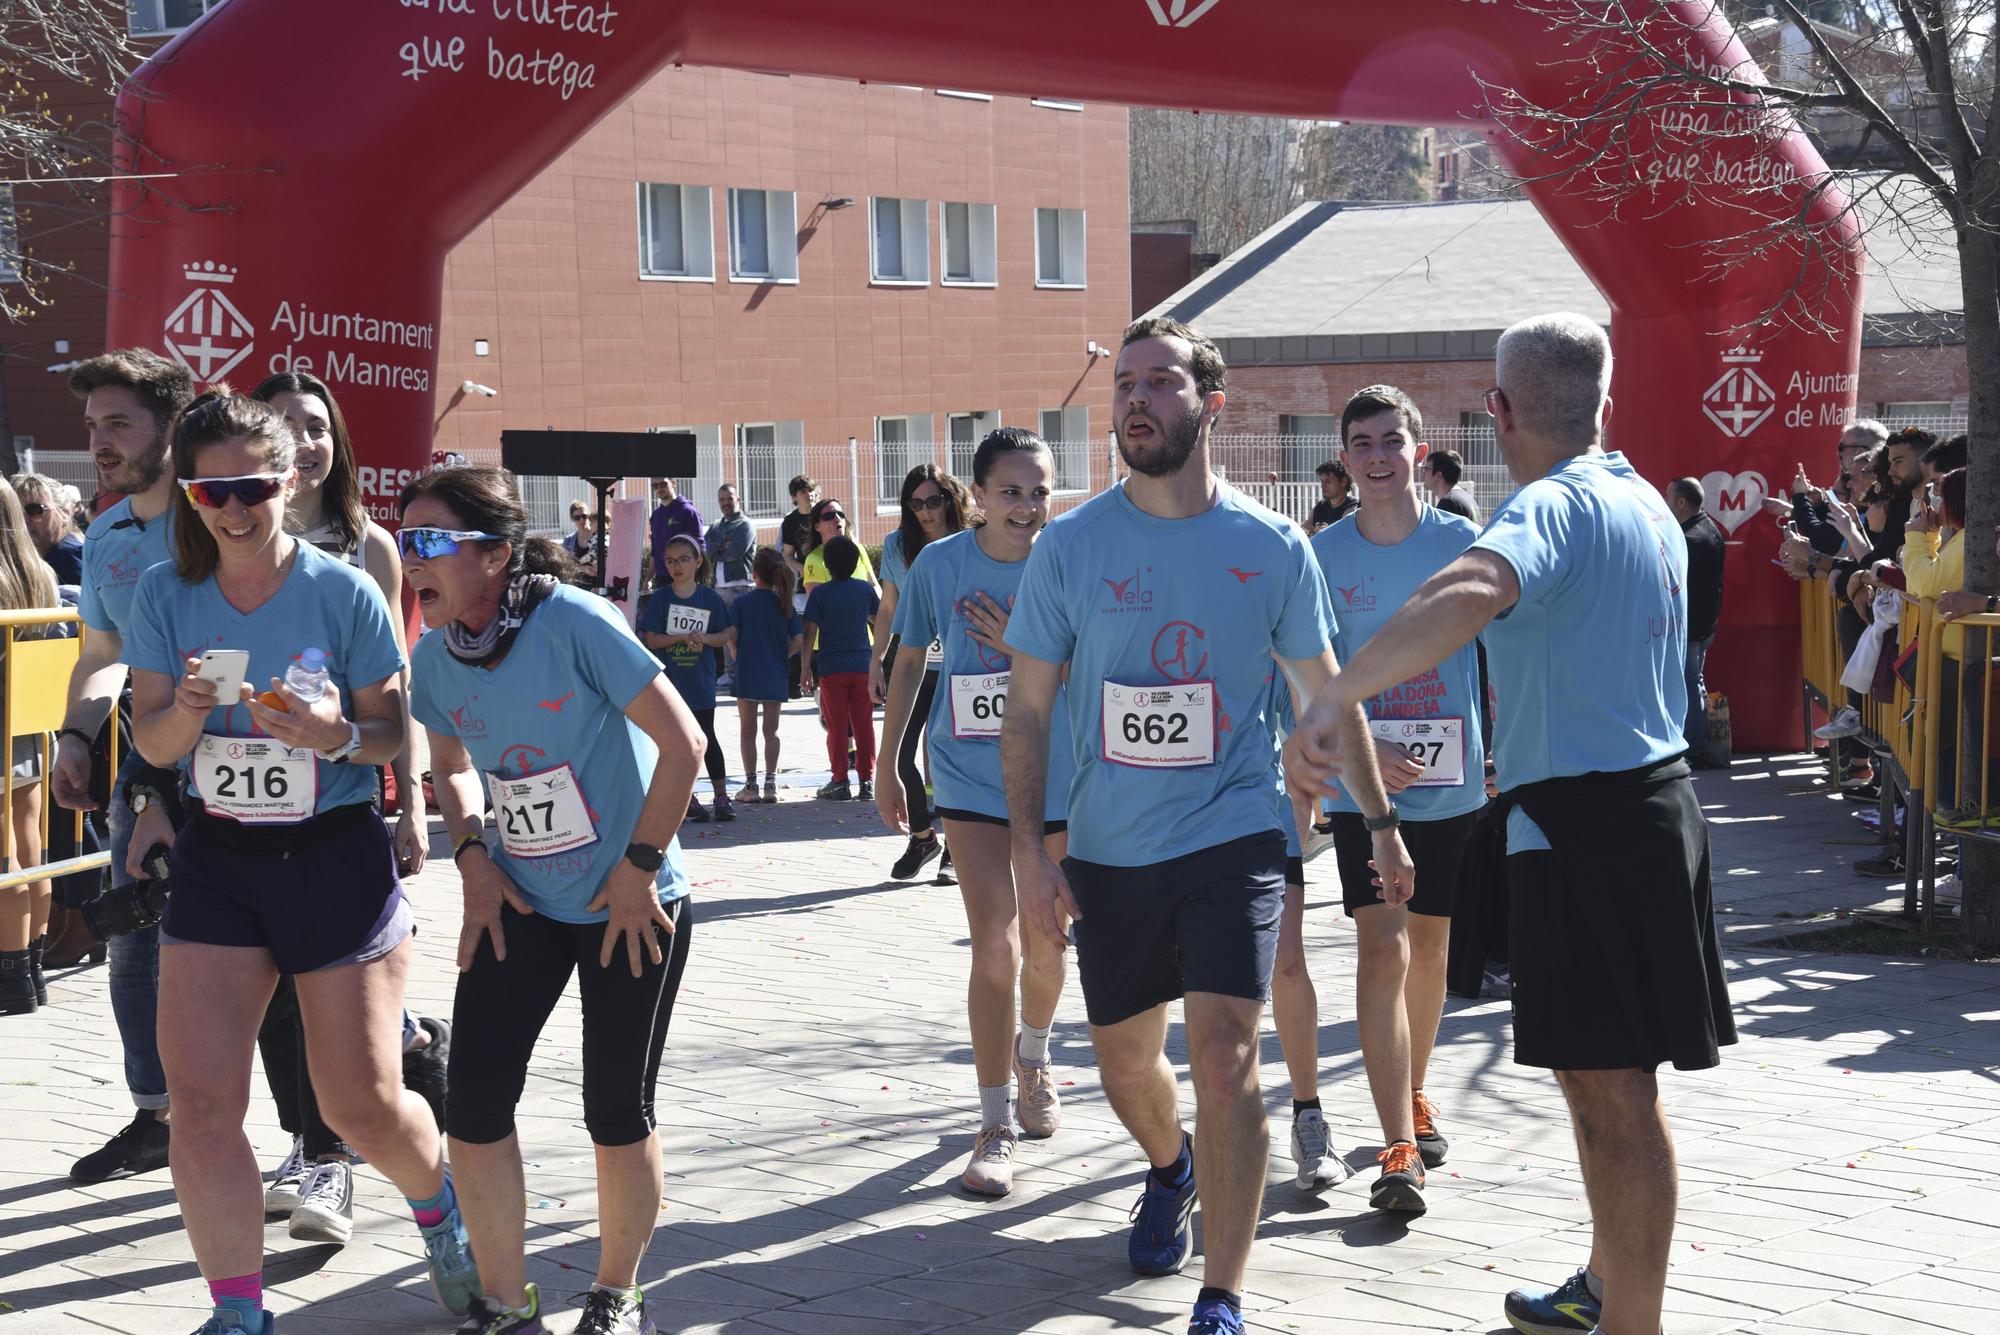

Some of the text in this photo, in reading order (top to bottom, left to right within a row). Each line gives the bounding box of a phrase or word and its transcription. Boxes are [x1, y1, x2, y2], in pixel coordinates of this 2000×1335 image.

[399, 36, 595, 100] que batega
[1647, 153, 1700, 187] que
[270, 300, 433, 350] Ajuntament
[268, 345, 430, 393] de Manresa
[1784, 403, 1813, 428] de
[1719, 490, 1747, 511] M
[673, 616, 704, 632] 1070
[1371, 698, 1440, 719] MANRESA
[1405, 681, 1448, 703] DONA
[1122, 712, 1189, 745] 662
[1397, 742, 1444, 767] 27
[215, 765, 288, 798] 216
[502, 800, 555, 835] 217
